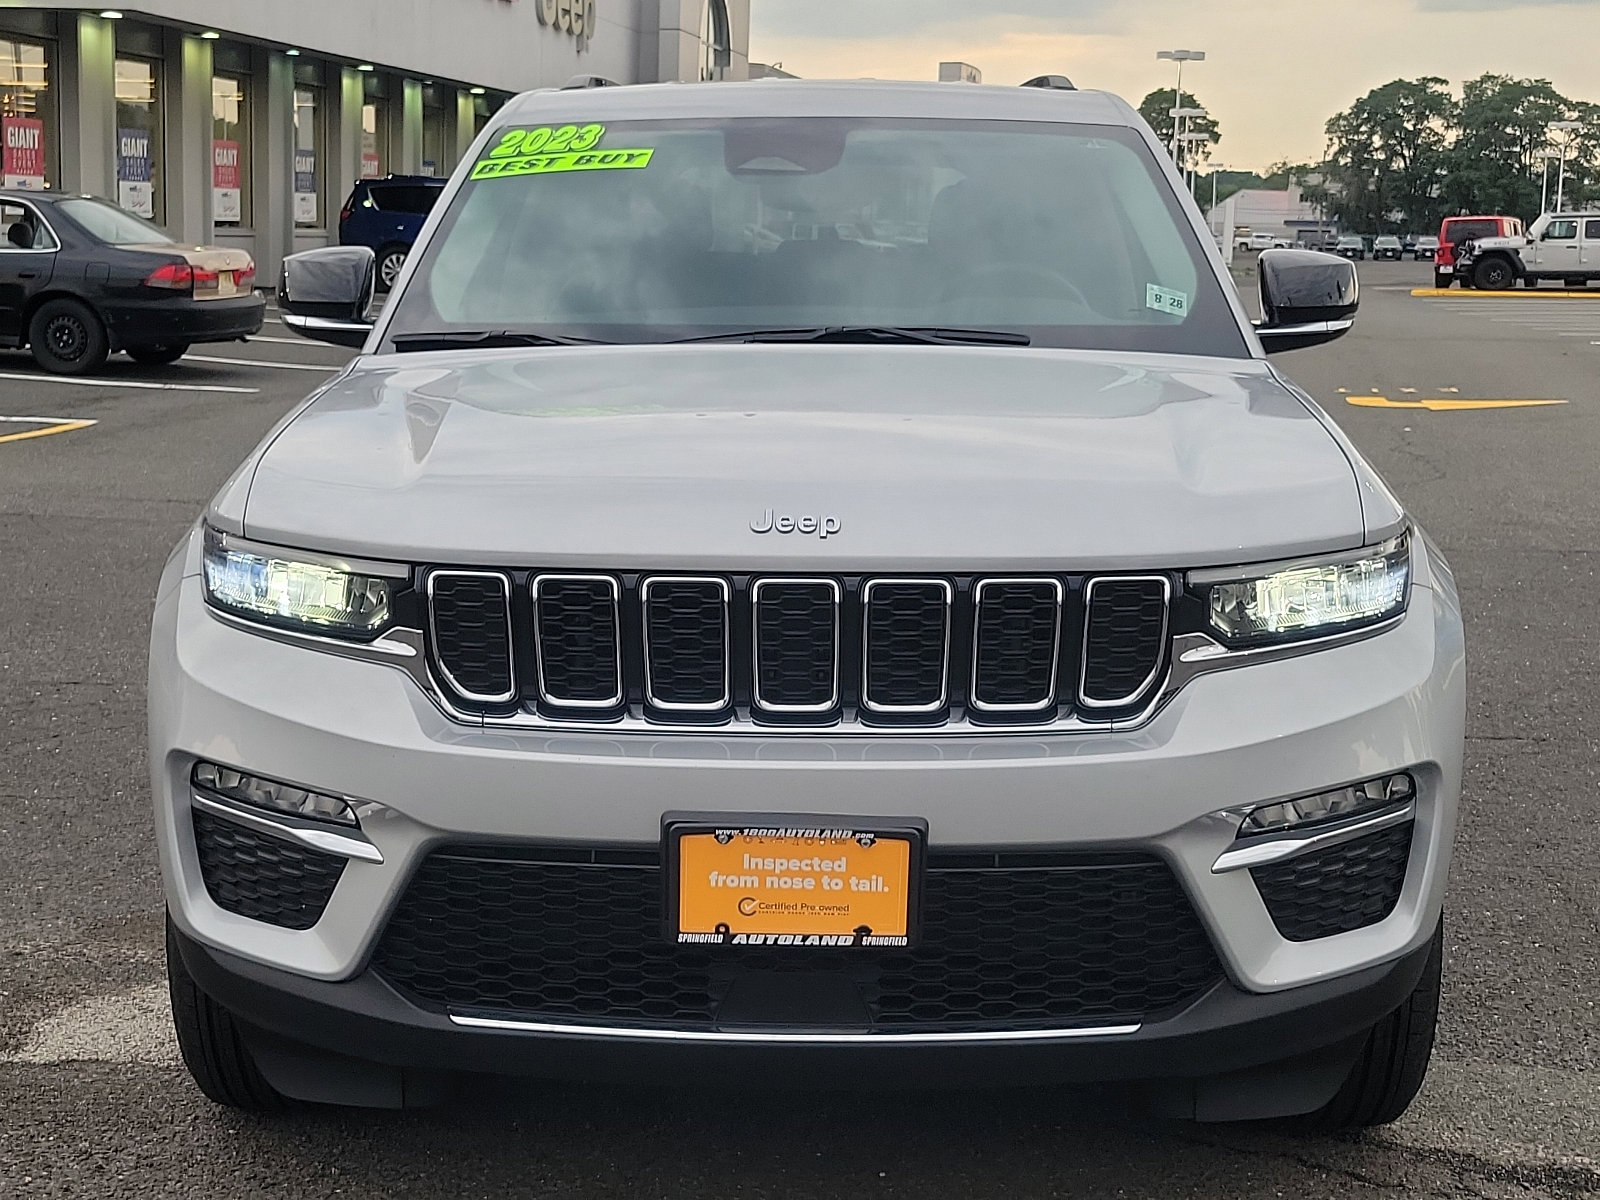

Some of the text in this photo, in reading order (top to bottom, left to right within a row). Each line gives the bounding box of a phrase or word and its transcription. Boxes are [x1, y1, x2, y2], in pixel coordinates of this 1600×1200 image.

[7, 126, 39, 150] GIANT
[121, 137, 148, 158] GIANT
[489, 124, 606, 159] 2023
[215, 148, 238, 167] GIANT
[475, 152, 649, 176] BEST BUY
[1154, 293, 1183, 309] 8 28
[749, 508, 842, 539] Jeep
[743, 853, 847, 873] Inspected
[709, 872, 890, 893] from nose to tail.
[758, 901, 798, 911] Certified
[677, 933, 908, 946] SPRINGFIELD AUTOLAND SPRINGFIELD
